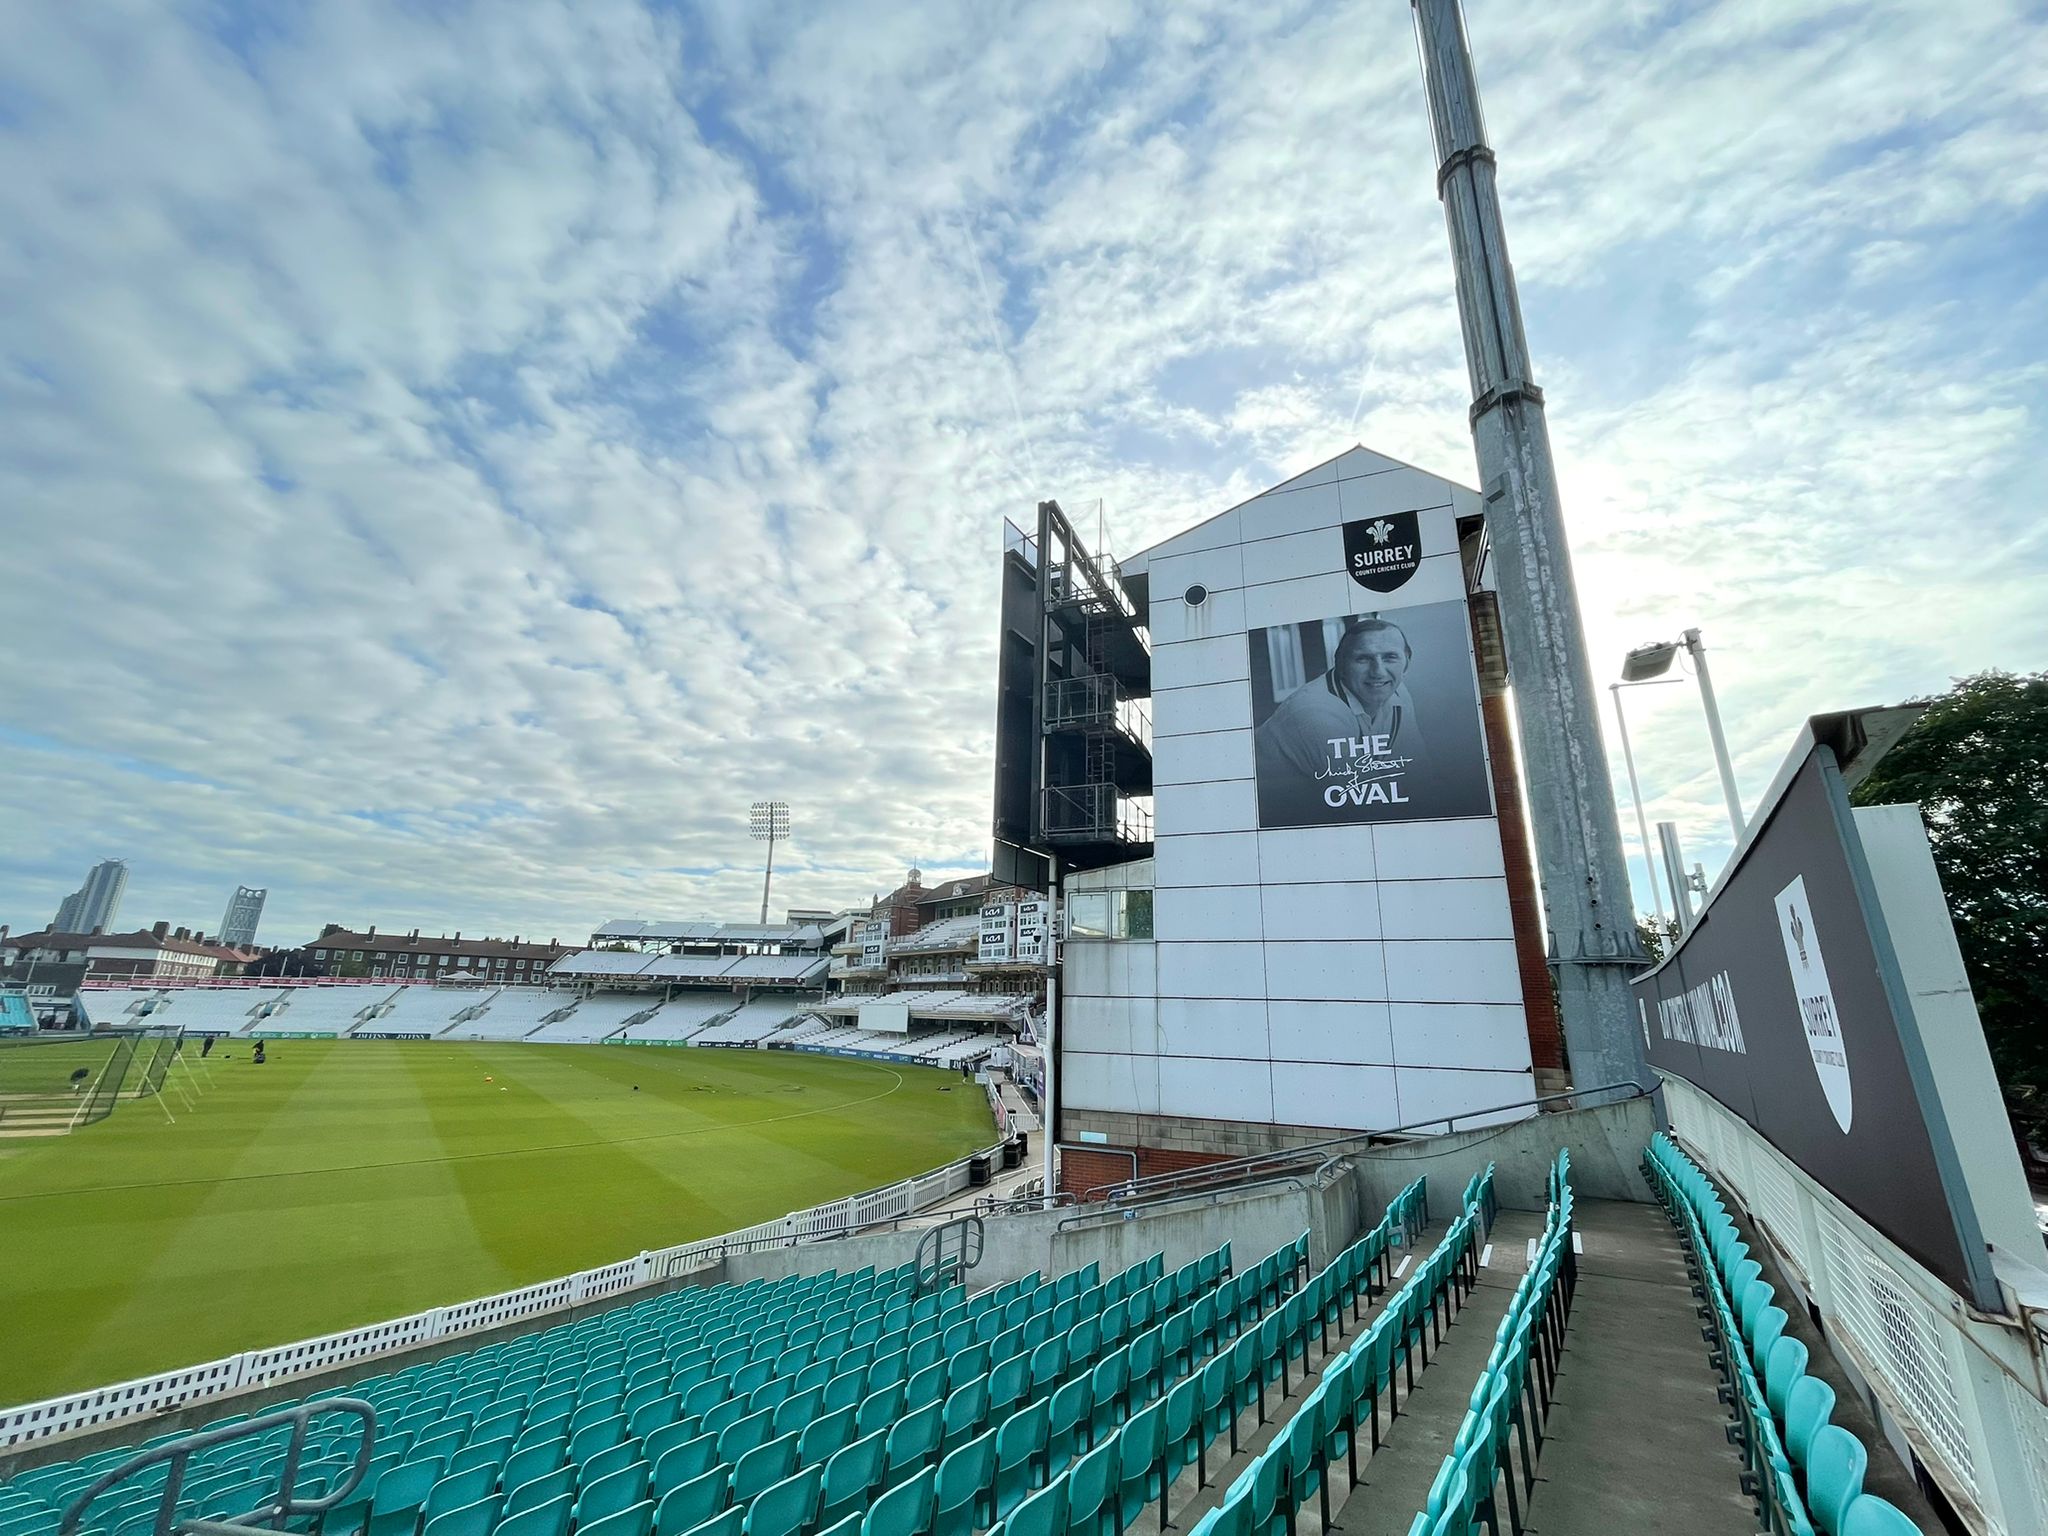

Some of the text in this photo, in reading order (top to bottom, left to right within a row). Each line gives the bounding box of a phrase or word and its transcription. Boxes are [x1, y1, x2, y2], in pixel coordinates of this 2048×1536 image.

[1353, 545, 1414, 568] SURREY
[1355, 561, 1416, 577] COUNTY CRICKET CLUB
[1327, 733, 1392, 759] THE
[1324, 781, 1409, 808] OVAL
[1801, 995, 1836, 1037] SURREY
